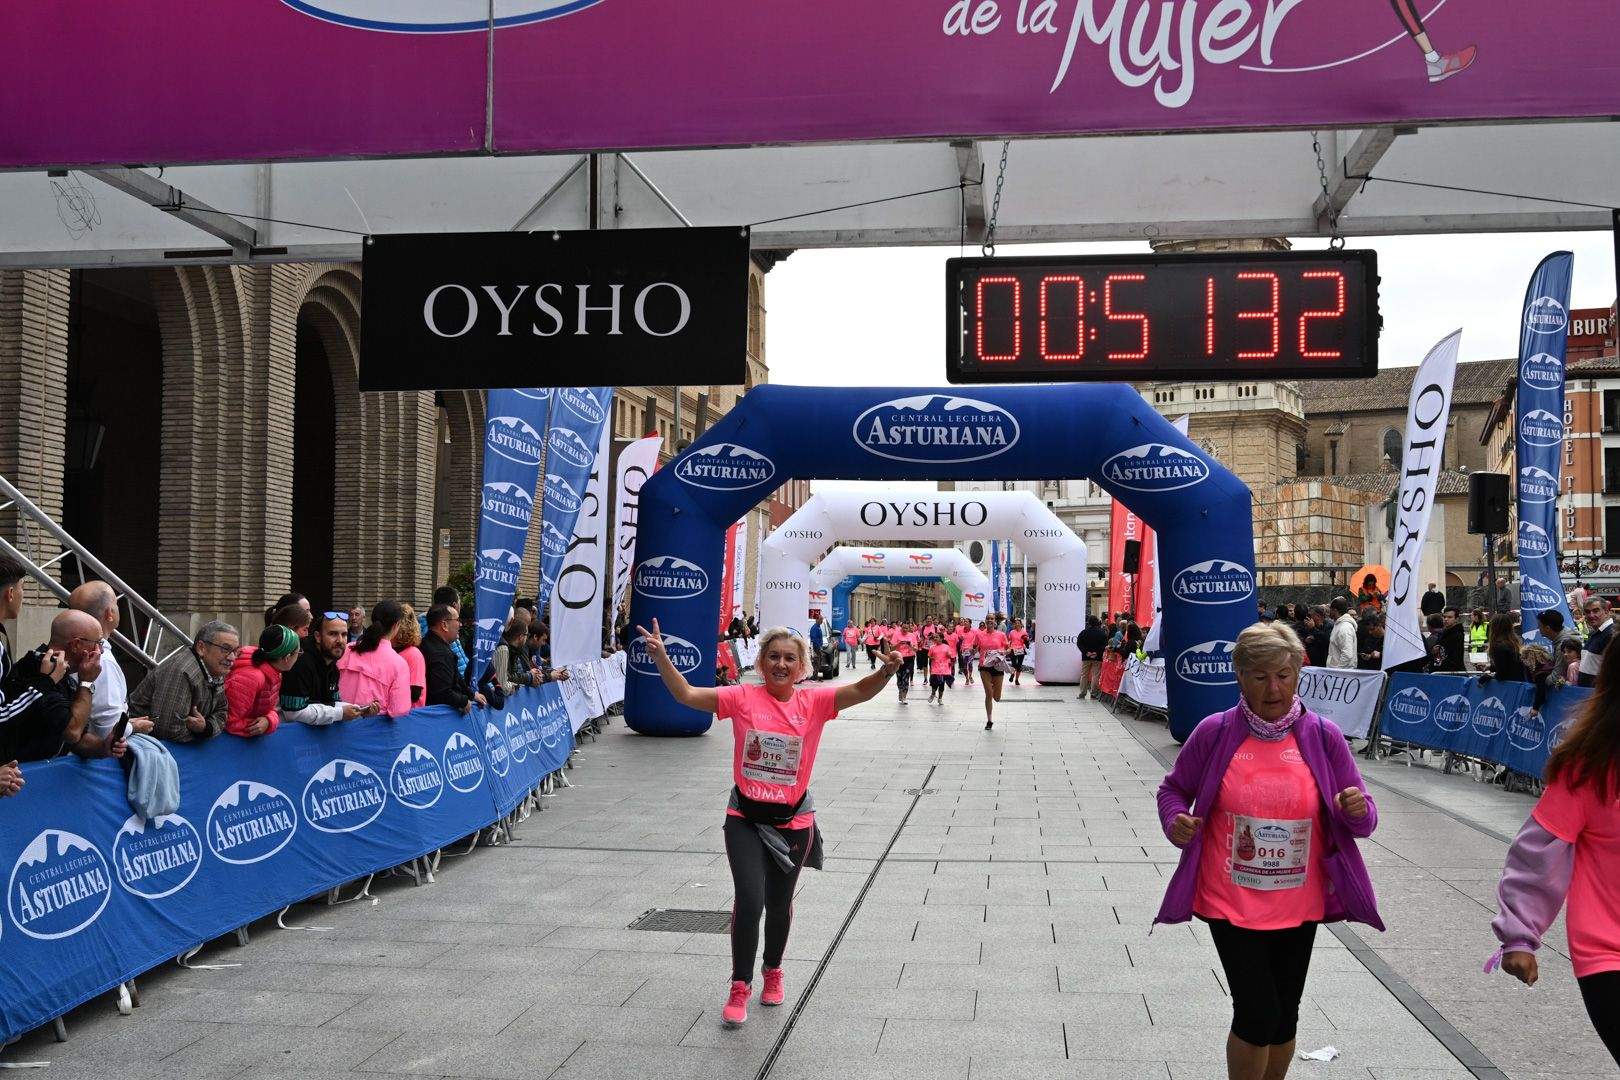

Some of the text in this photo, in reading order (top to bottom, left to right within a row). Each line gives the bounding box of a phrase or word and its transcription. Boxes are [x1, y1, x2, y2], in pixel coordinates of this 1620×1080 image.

[942, 0, 1300, 108] de la Mujer
[423, 282, 691, 339] OYSHO
[891, 414, 1001, 422] CENTRAL LECHERA
[865, 416, 1007, 445] ASTURIANA
[1563, 400, 1574, 466] HOTEL
[549, 432, 588, 464] ASTURIANA
[680, 459, 767, 479] ASTURIANA
[1111, 463, 1203, 480] ASTURIANA
[1393, 383, 1445, 606] OYSHO
[859, 500, 988, 528] OYSHO
[784, 530, 823, 540] OYSHO
[1023, 529, 1063, 538] OYSHO
[636, 570, 703, 590] ASTURIANA
[765, 581, 801, 591] OYSHO
[1044, 582, 1080, 592] OYSHO
[1178, 577, 1251, 594] ASTURIANA
[1042, 635, 1078, 644] OYSHO
[1297, 672, 1361, 704] OYSHO
[1392, 697, 1427, 717] ASTURIANA
[762, 751, 782, 761] 016
[447, 757, 482, 781] ASTURIANA
[397, 770, 441, 797] ASTURIANA
[746, 786, 786, 800] SUMA
[223, 799, 284, 823] CENTRAL LECHERA
[312, 786, 382, 821] ASTURIANA
[129, 828, 189, 851] CENTRAL LECHERA
[215, 810, 293, 852] ASTURIANA
[122, 840, 198, 883] ASTURIANA
[1258, 847, 1285, 858] 016
[1262, 860, 1280, 868] 9988
[29, 854, 97, 886] CENTRAL LECHERA
[20, 867, 108, 924] ASTURIANA
